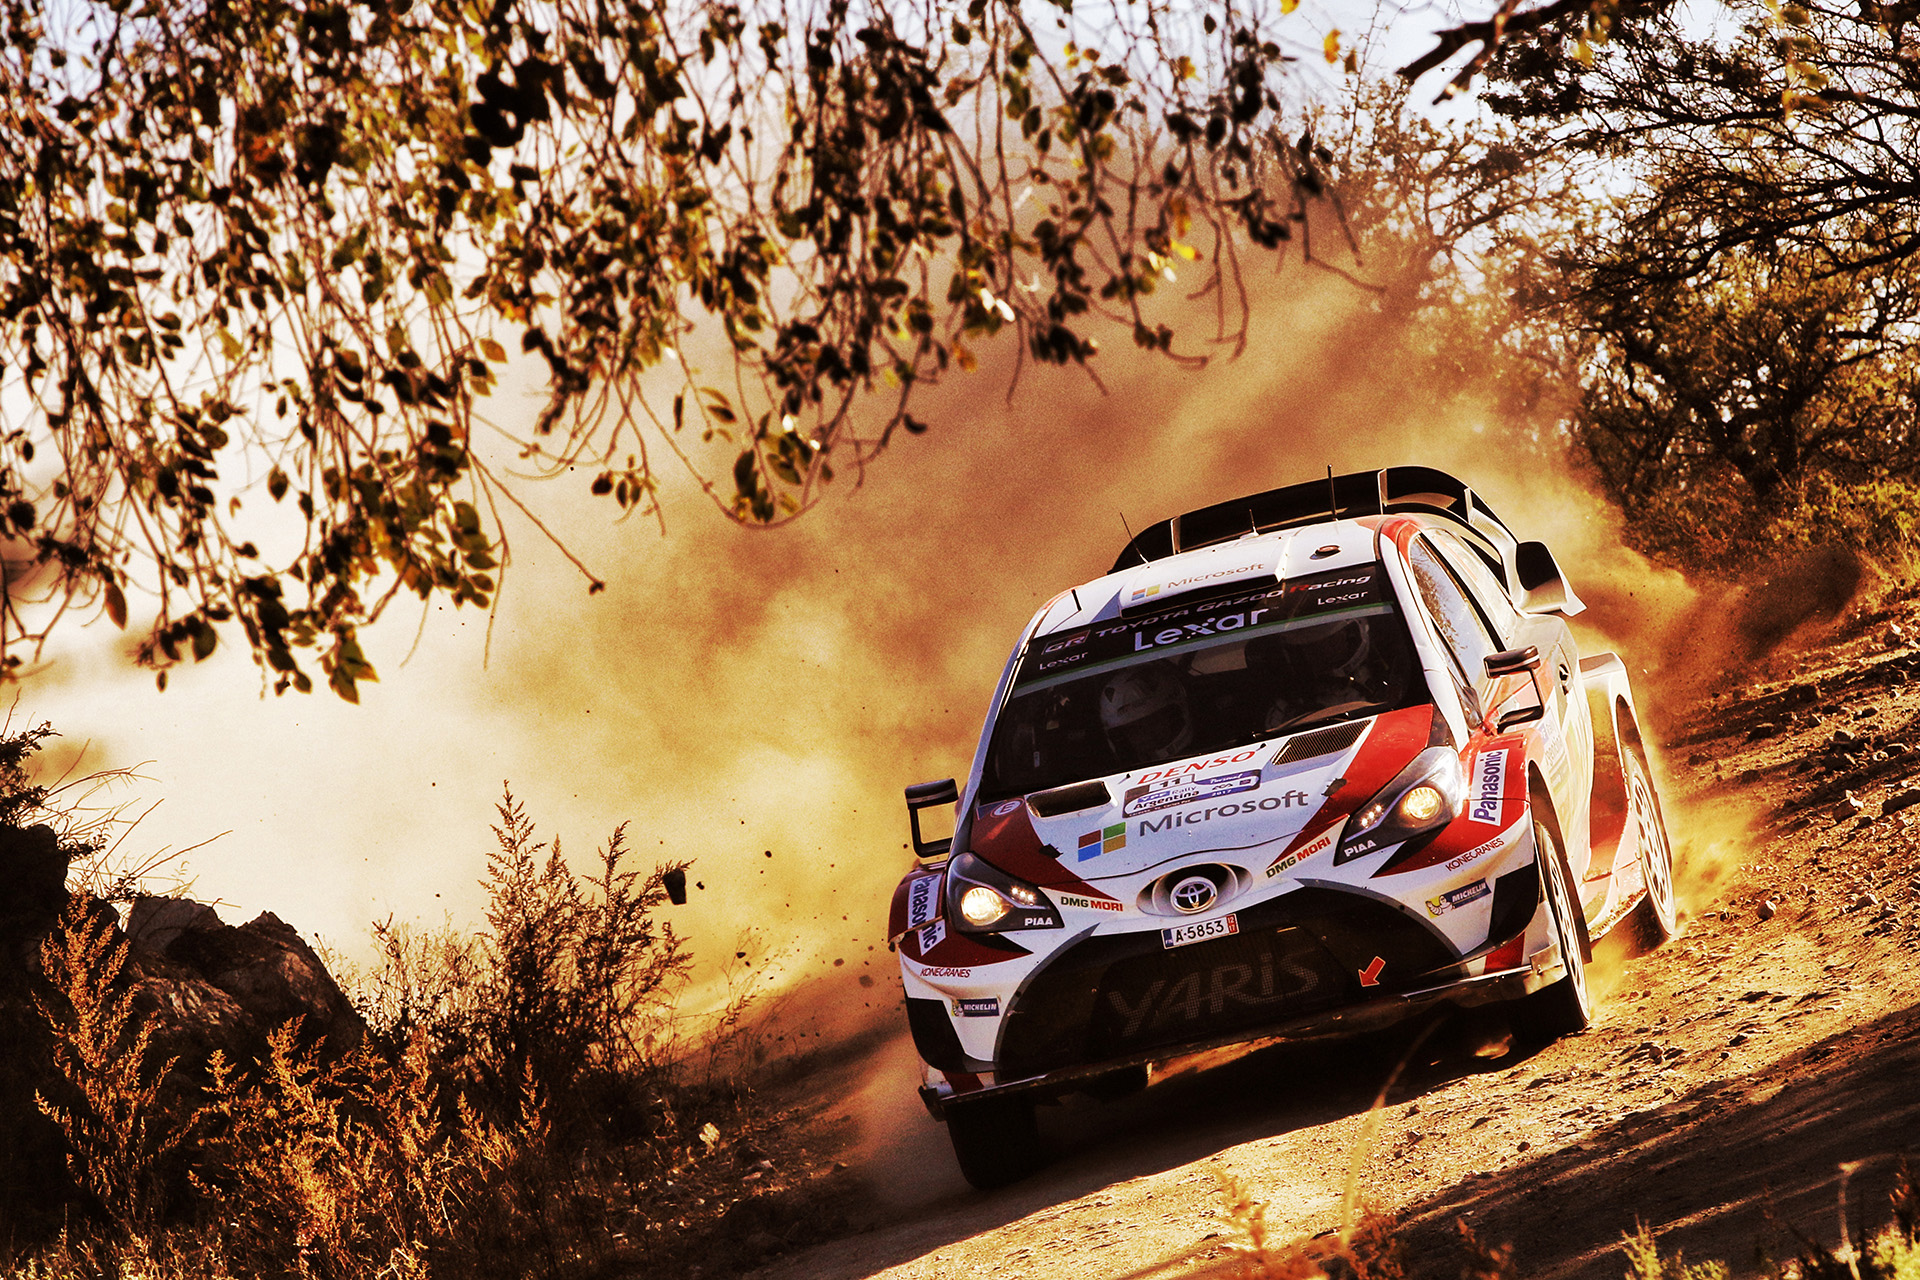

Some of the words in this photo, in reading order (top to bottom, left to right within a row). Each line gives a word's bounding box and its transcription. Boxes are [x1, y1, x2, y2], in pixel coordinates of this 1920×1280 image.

[1167, 562, 1265, 589] Microsoft
[1317, 590, 1369, 606] Lexar
[1044, 635, 1087, 653] GR
[1095, 608, 1189, 638] TOYOTA
[1196, 589, 1284, 613] GAZOO
[1289, 575, 1372, 594] Racing
[1134, 608, 1269, 651] Lexar
[1039, 651, 1089, 670] Lexar
[1137, 750, 1256, 785] DENSO
[1160, 777, 1181, 788] 11
[1171, 785, 1196, 795] Rally
[1473, 751, 1503, 822] Panasonic
[1133, 790, 1200, 811] Argentina
[1139, 789, 1309, 837] Microsoft
[1266, 855, 1297, 879] DMG
[1296, 836, 1332, 862] MORI
[1343, 839, 1377, 858] PIAA
[1445, 837, 1505, 872] KONECRANES
[1451, 881, 1487, 903] MICHELIN
[912, 874, 942, 949] Panasonic
[1060, 896, 1089, 908] DMG
[1090, 900, 1124, 912] MORI
[1024, 917, 1054, 927] PIAA
[920, 967, 972, 978] KONECRANES
[963, 1003, 998, 1012] MICHELIN
